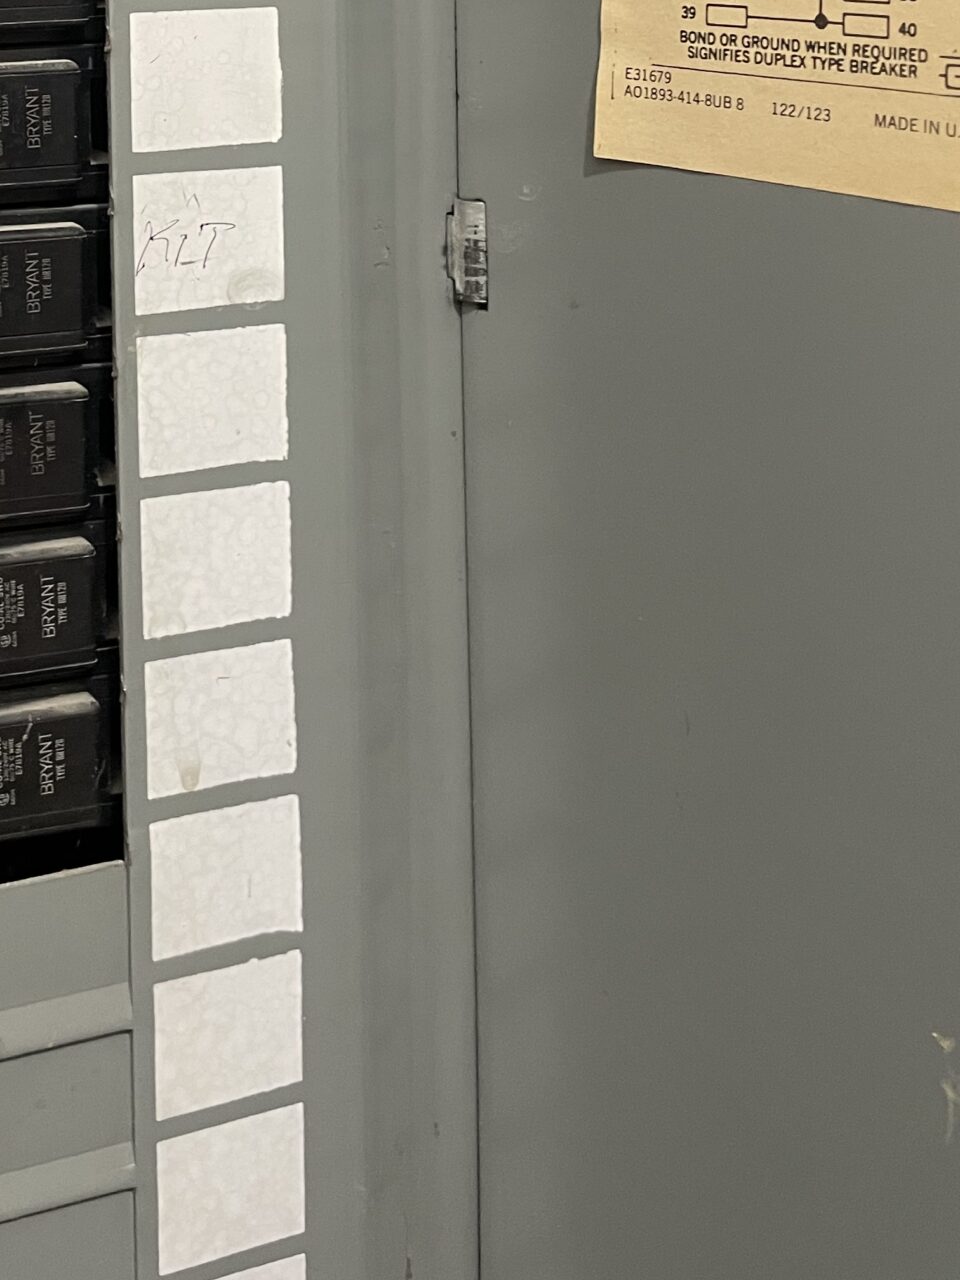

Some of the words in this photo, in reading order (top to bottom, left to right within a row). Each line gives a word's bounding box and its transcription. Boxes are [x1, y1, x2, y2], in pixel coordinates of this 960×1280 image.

[681, 6, 696, 19] 39
[898, 23, 917, 37] 40
[680, 30, 717, 45] BOND
[720, 33, 738, 47] OR
[741, 35, 801, 52] GROUND
[805, 41, 847, 57] WHEN
[852, 44, 928, 63] REQUIRED
[624, 67, 673, 84] E31679
[687, 47, 750, 65] SIGNIFIES
[754, 52, 807, 69] DUPLEX
[811, 56, 846, 72] TYPE
[849, 59, 918, 78] BREAKER
[25, 86, 41, 149] BRYANT
[736, 97, 745, 111] 8
[771, 102, 832, 123] 122/123
[874, 114, 920, 133] MADE
[923, 116, 940, 135] IN
[24, 249, 41, 314] BRYANT
[28, 412, 45, 475] BRYANT
[40, 575, 57, 638] BRYANT
[38, 733, 54, 795] BRYANT
